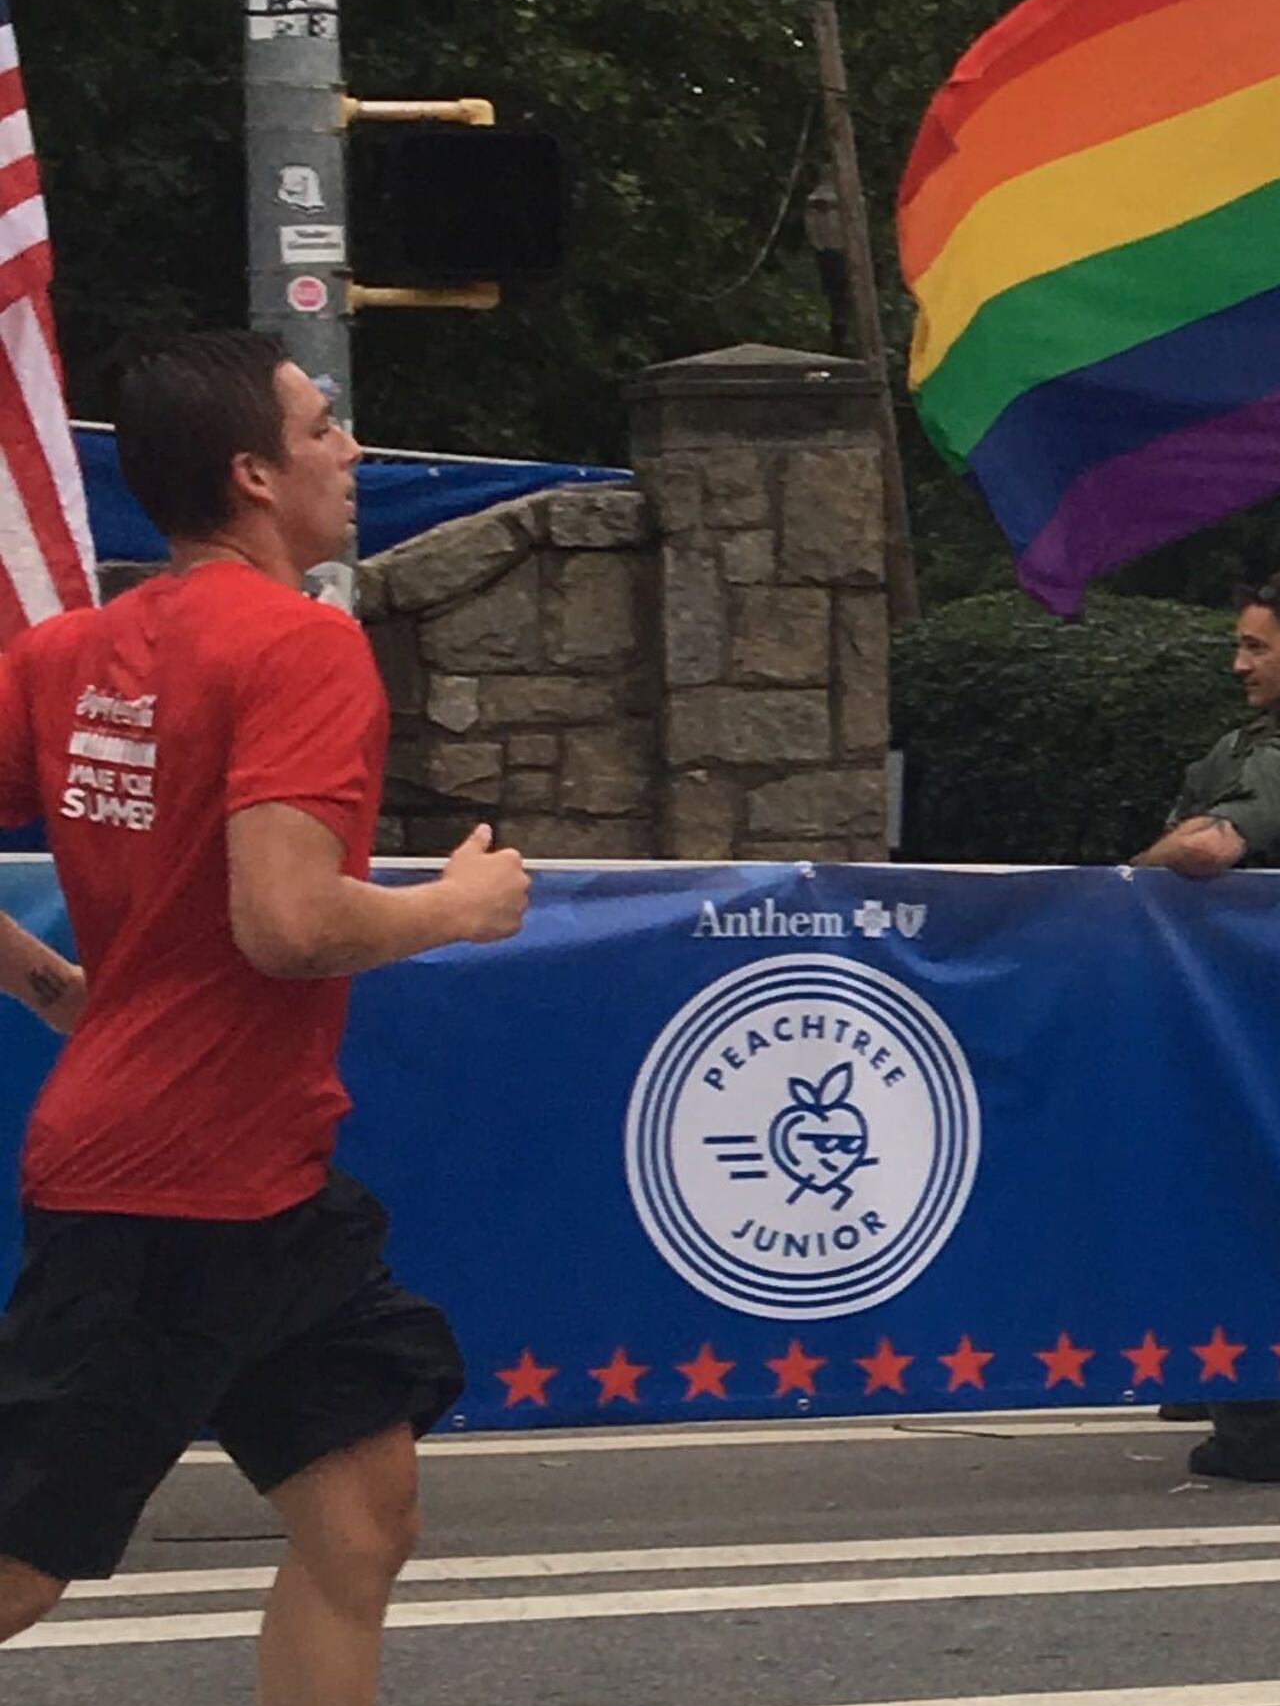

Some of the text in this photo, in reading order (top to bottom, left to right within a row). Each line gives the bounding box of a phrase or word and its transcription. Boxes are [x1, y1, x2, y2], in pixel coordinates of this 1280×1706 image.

[692, 899, 847, 939] Anthem
[703, 1013, 908, 1092] PEACHTREE
[731, 1209, 888, 1258] JUNIOR
